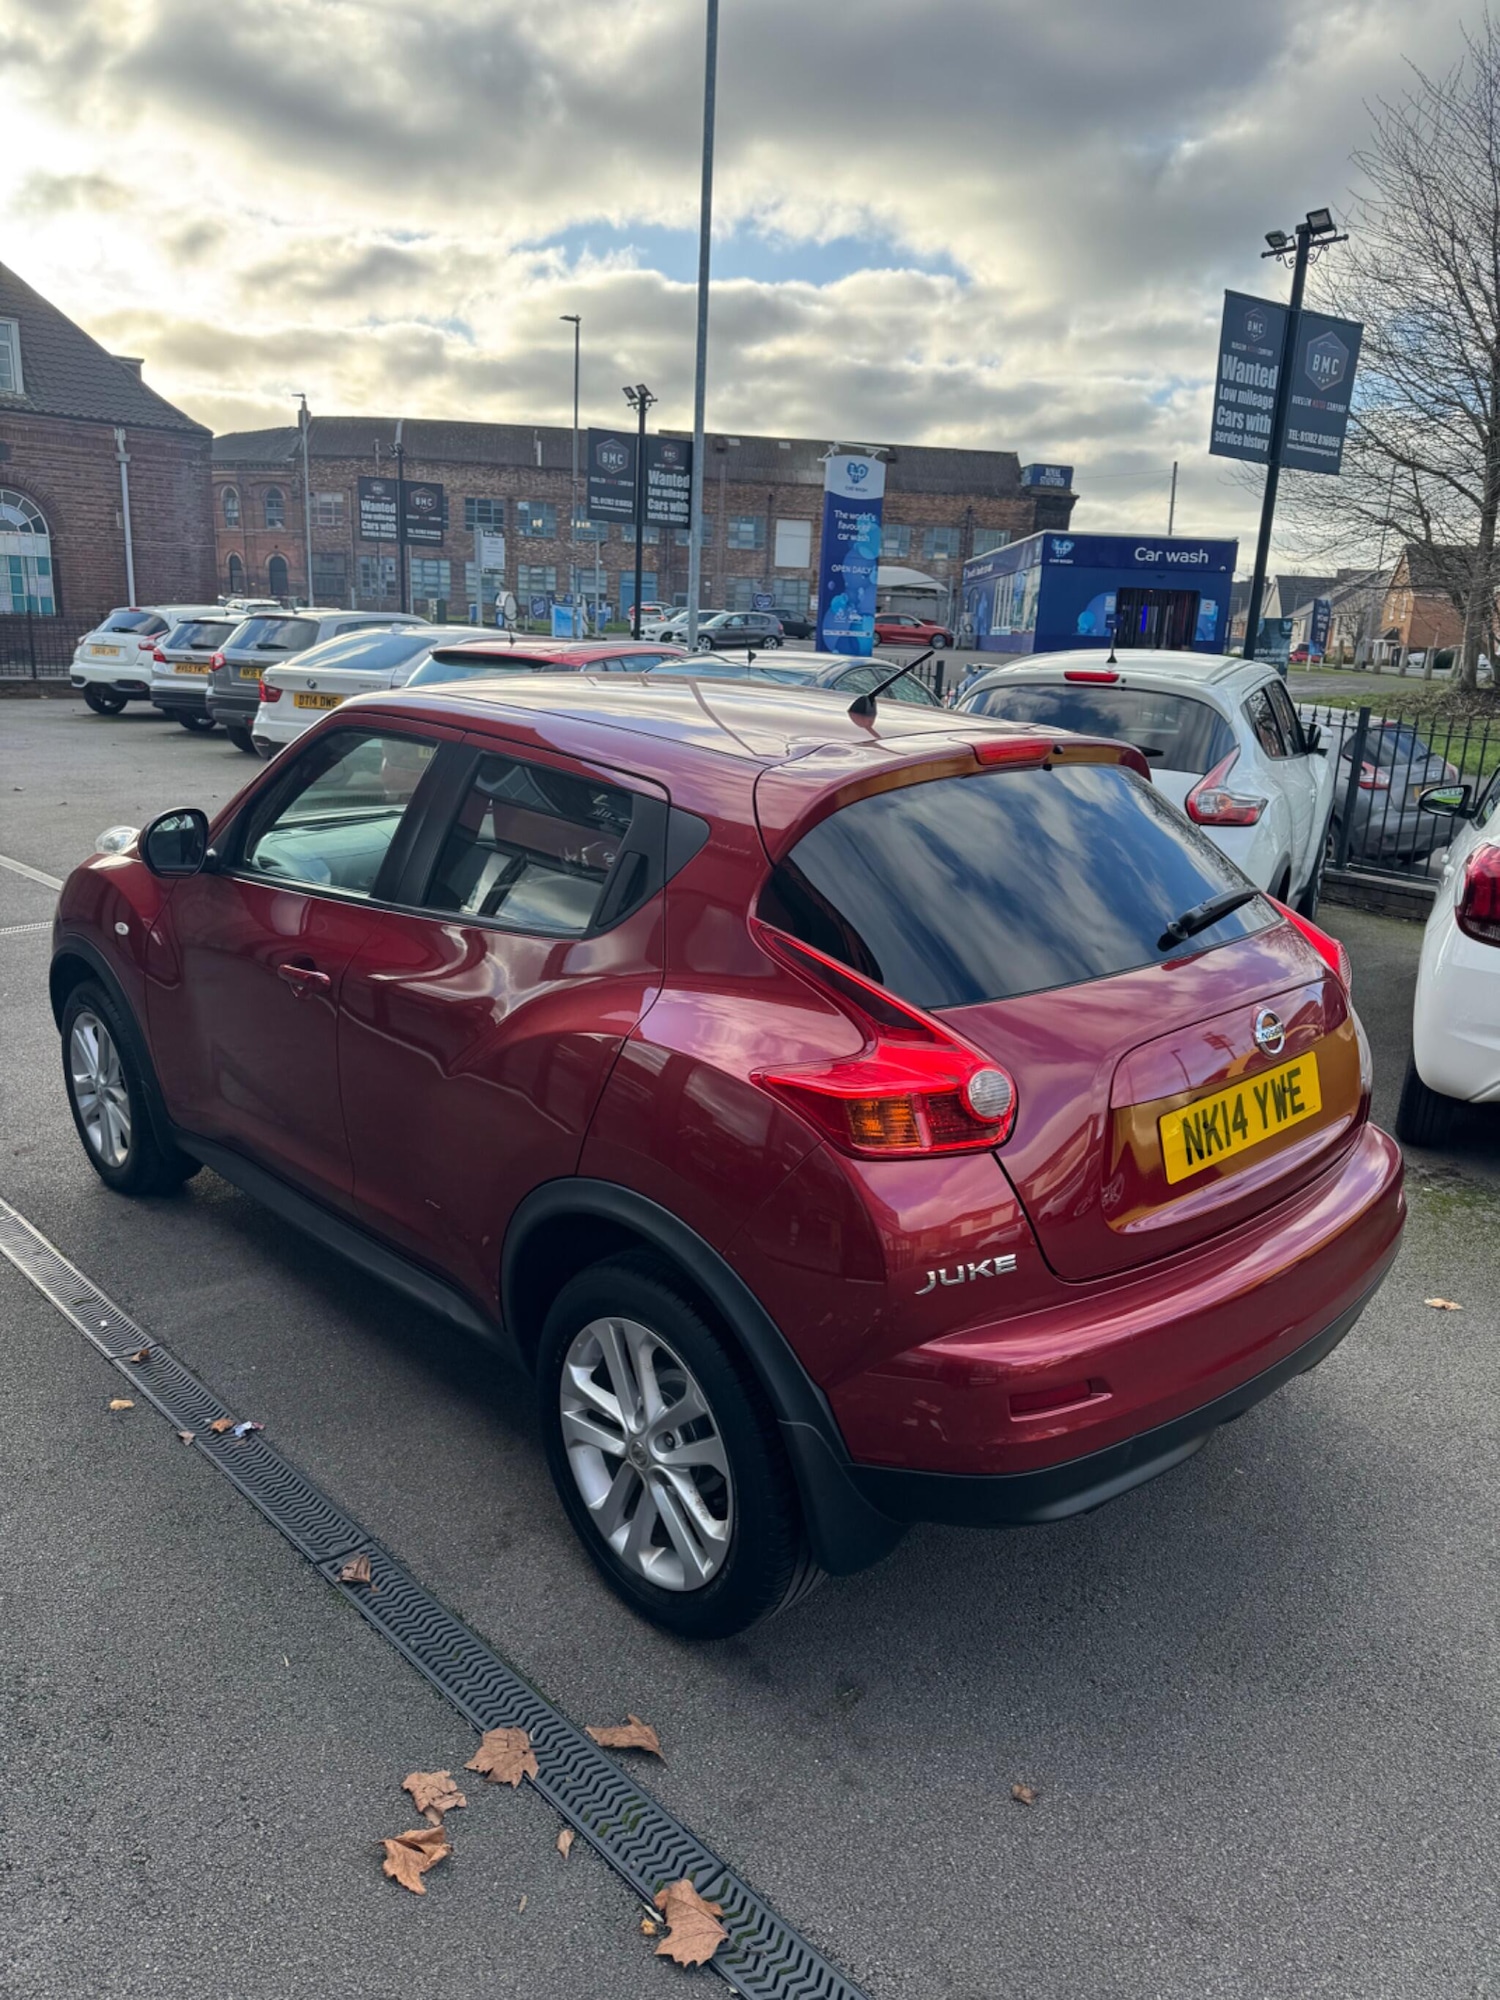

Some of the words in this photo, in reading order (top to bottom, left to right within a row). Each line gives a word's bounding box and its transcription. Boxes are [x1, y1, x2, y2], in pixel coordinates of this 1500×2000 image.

[1247, 320, 1264, 334] BMC
[1222, 353, 1279, 390] Wanted
[1312, 354, 1340, 375] BMC
[1219, 384, 1237, 403] Low
[1238, 389, 1274, 410] mileage
[1216, 405, 1245, 429] Cars
[1246, 413, 1272, 434] with
[1215, 430, 1242, 446] service
[1243, 434, 1270, 452] history
[602, 452, 624, 465] BMC
[648, 469, 690, 488] Wanted
[648, 486, 661, 496] Low
[662, 488, 689, 500] mileage
[360, 500, 396, 514] Wanted
[647, 498, 668, 511] Cars
[670, 501, 689, 513] with
[834, 509, 848, 519] The
[361, 520, 378, 530] Cars
[380, 522, 396, 532] with
[837, 532, 848, 541] car
[850, 532, 871, 541] wash
[1134, 547, 1163, 562] Car
[1166, 549, 1209, 564] wash
[831, 564, 851, 573] OPEN
[852, 565, 872, 574] DAILY
[299, 694, 317, 706] DT14
[320, 695, 338, 707] DWE
[1182, 1092, 1249, 1166] NK14
[1253, 1066, 1306, 1130] YWE
[914, 1253, 1018, 1295] JUKE
